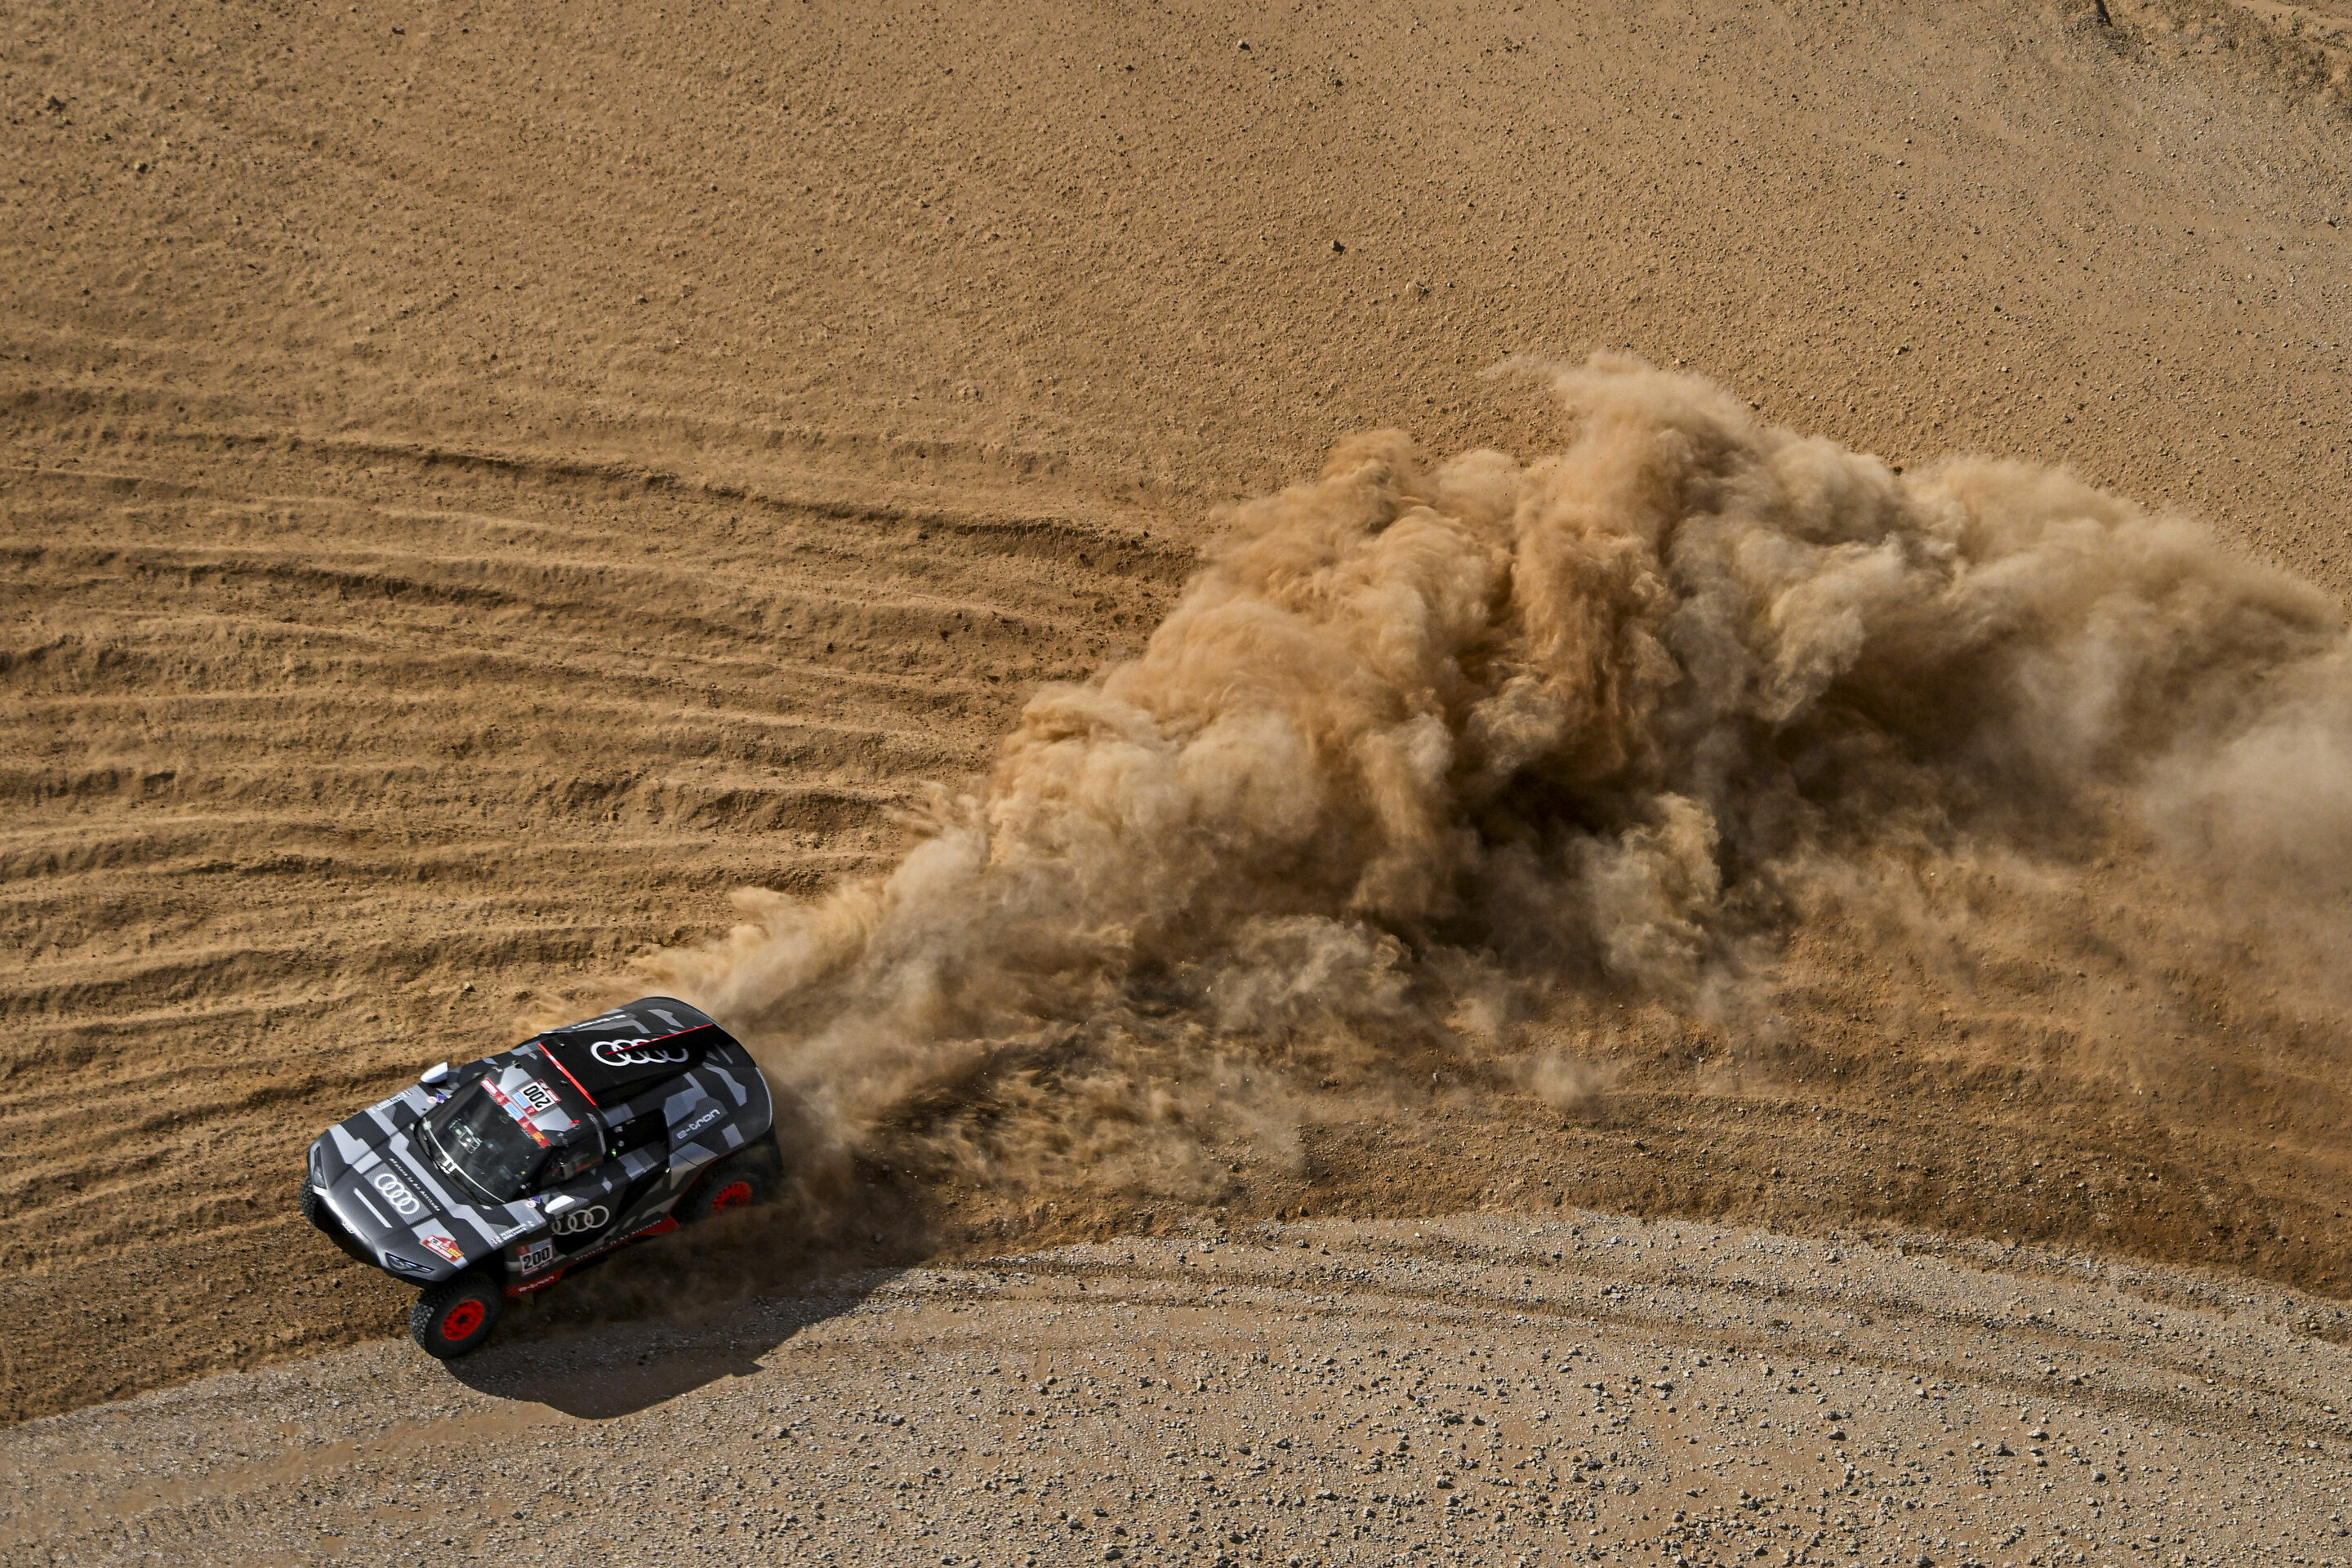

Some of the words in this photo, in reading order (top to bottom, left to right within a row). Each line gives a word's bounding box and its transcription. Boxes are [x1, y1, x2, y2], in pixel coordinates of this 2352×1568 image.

[523, 1085, 551, 1108] 200
[676, 1109, 720, 1139] e-tron
[523, 1247, 550, 1269] 200
[519, 1276, 555, 1292] e-tron
